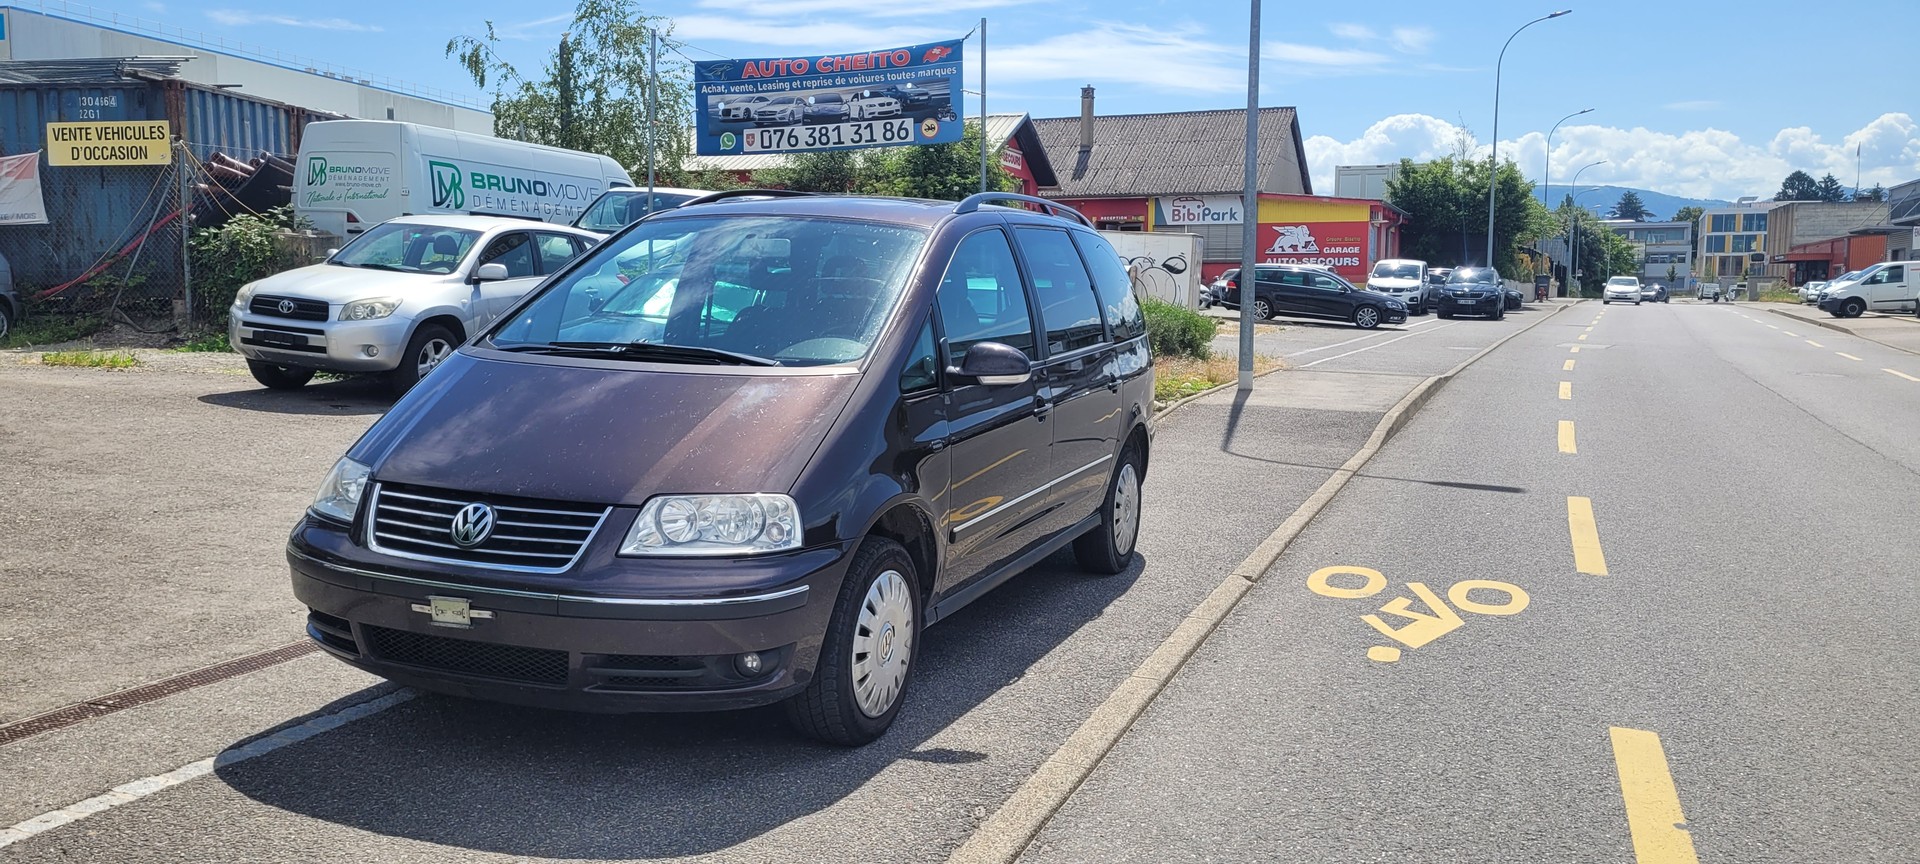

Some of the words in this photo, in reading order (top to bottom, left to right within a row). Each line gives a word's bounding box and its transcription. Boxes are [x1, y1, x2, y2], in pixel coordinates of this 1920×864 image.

[741, 58, 810, 79] AUTO
[816, 49, 911, 73] CHEITO
[701, 84, 728, 94] Achat,
[730, 83, 756, 93] vente,
[757, 80, 790, 91] Leasing
[792, 80, 801, 89] et
[803, 76, 833, 89] reprise
[835, 76, 846, 85] de
[848, 73, 885, 84] voitures
[886, 72, 916, 81] toutes
[917, 66, 957, 79] marques
[52, 127, 93, 141] VENTE
[95, 125, 165, 140] VEHICULES
[760, 128, 799, 149] 076
[804, 125, 845, 147] 381
[850, 122, 877, 144] 31
[882, 120, 910, 142] 86
[71, 145, 148, 160] D'OCCASION
[329, 166, 390, 175] BRUNOMOVE
[471, 172, 599, 202] BRUNOMOVE
[473, 193, 583, 217] DÉMÉNAGEME
[1172, 205, 1238, 222] BibiPark
[16, 212, 37, 220] MOIS
[1266, 257, 1360, 266] AUTO-SECOURS
